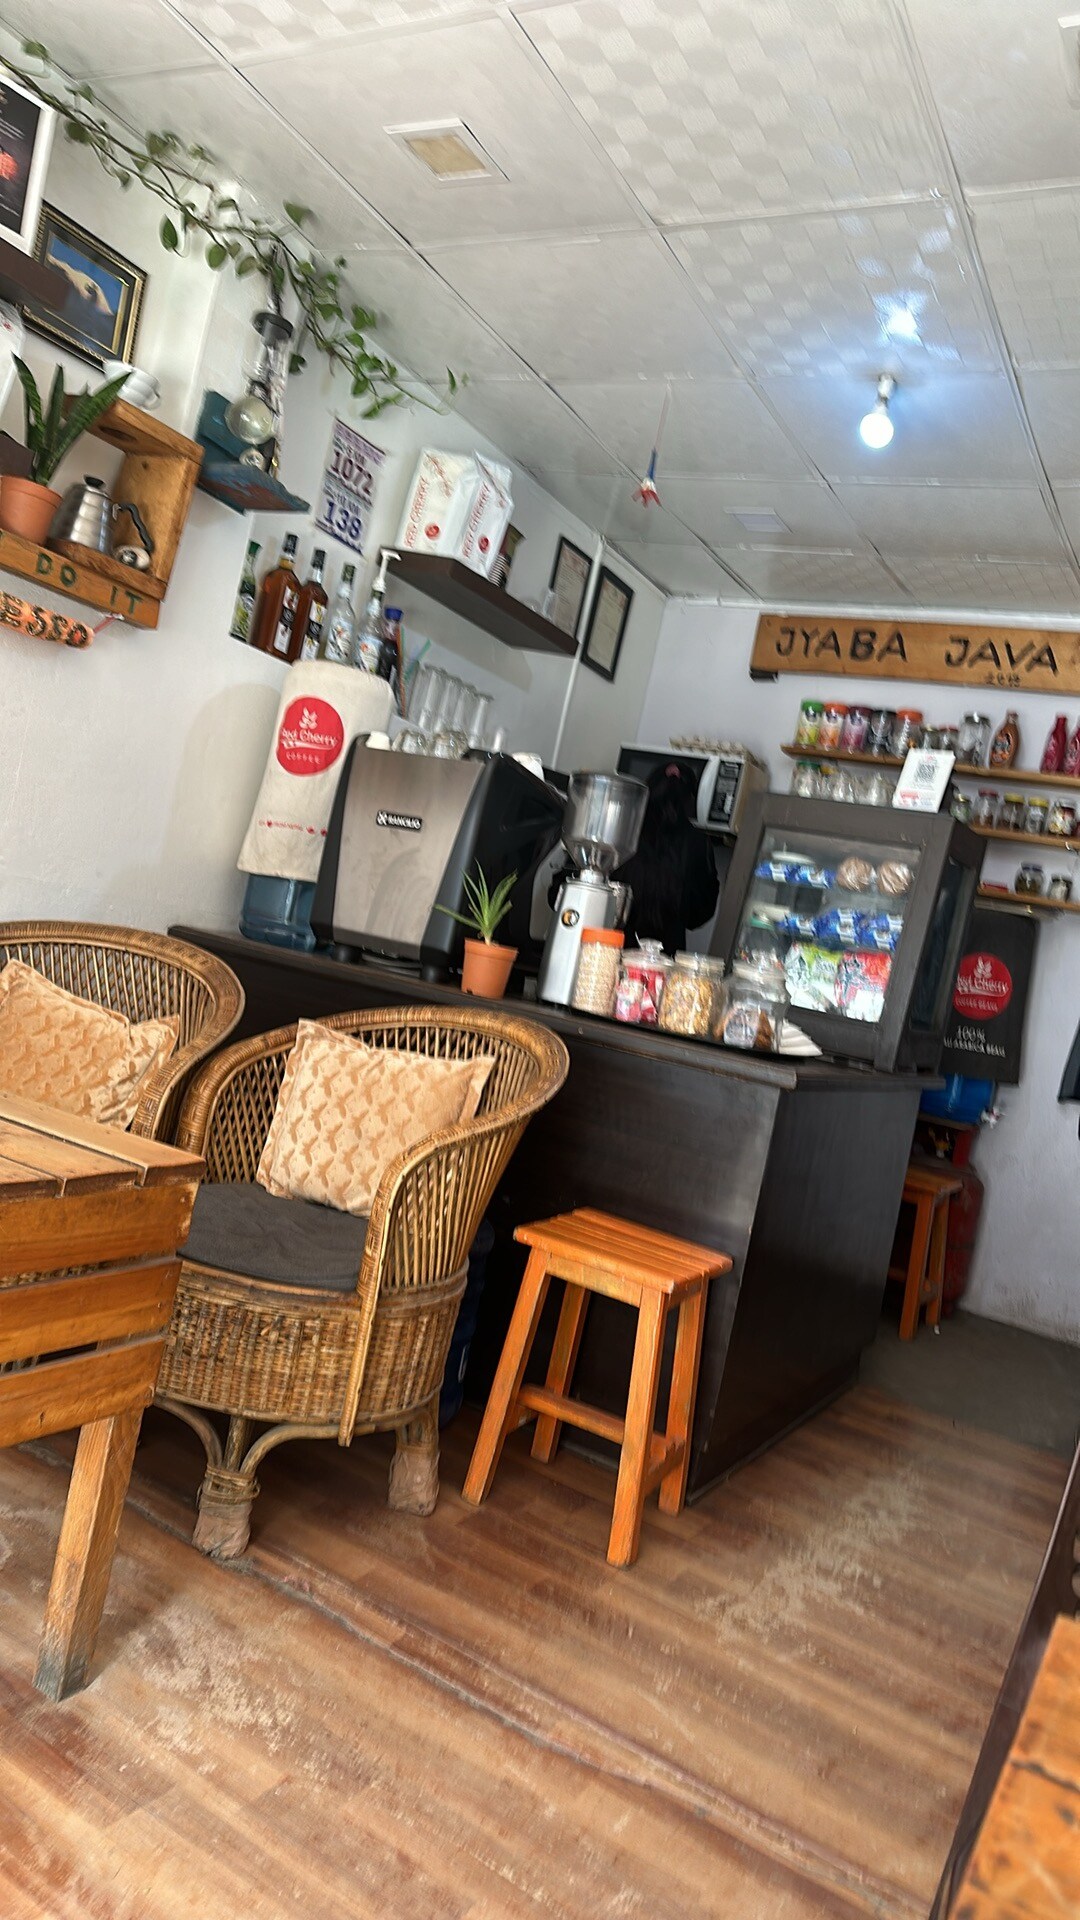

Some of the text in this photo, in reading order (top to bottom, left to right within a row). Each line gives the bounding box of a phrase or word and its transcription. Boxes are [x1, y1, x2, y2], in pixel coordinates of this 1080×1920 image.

[330, 449, 374, 496] 1072
[323, 499, 362, 540] 138
[36, 552, 144, 615] DO IT
[775, 626, 1059, 676] JYABA JAVA
[299, 728, 338, 747] Cherry
[957, 1025, 986, 1043] 100%
